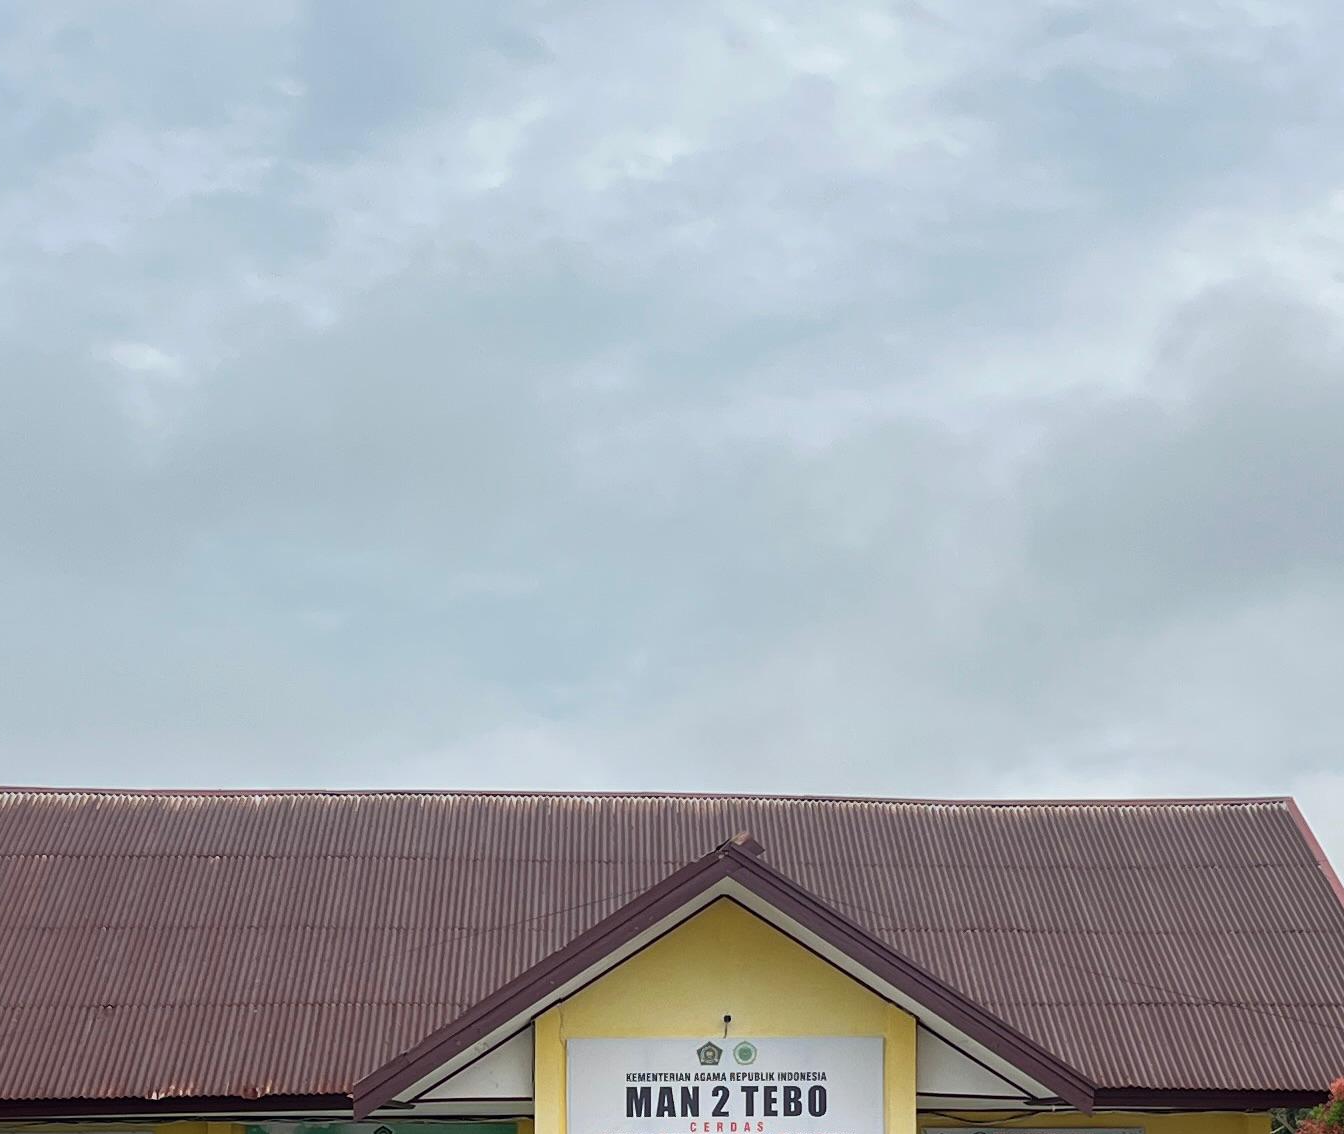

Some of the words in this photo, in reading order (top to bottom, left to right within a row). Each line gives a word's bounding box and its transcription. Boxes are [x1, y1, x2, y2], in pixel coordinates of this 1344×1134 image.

[626, 1072, 691, 1082] KEMENTERIAN
[693, 1072, 727, 1082] AGAMA
[729, 1072, 775, 1082] REPUBLIK
[777, 1071, 828, 1082] INDONESIA
[625, 1086, 700, 1118] MAN
[711, 1085, 731, 1117] 2
[741, 1084, 828, 1117] TEBO
